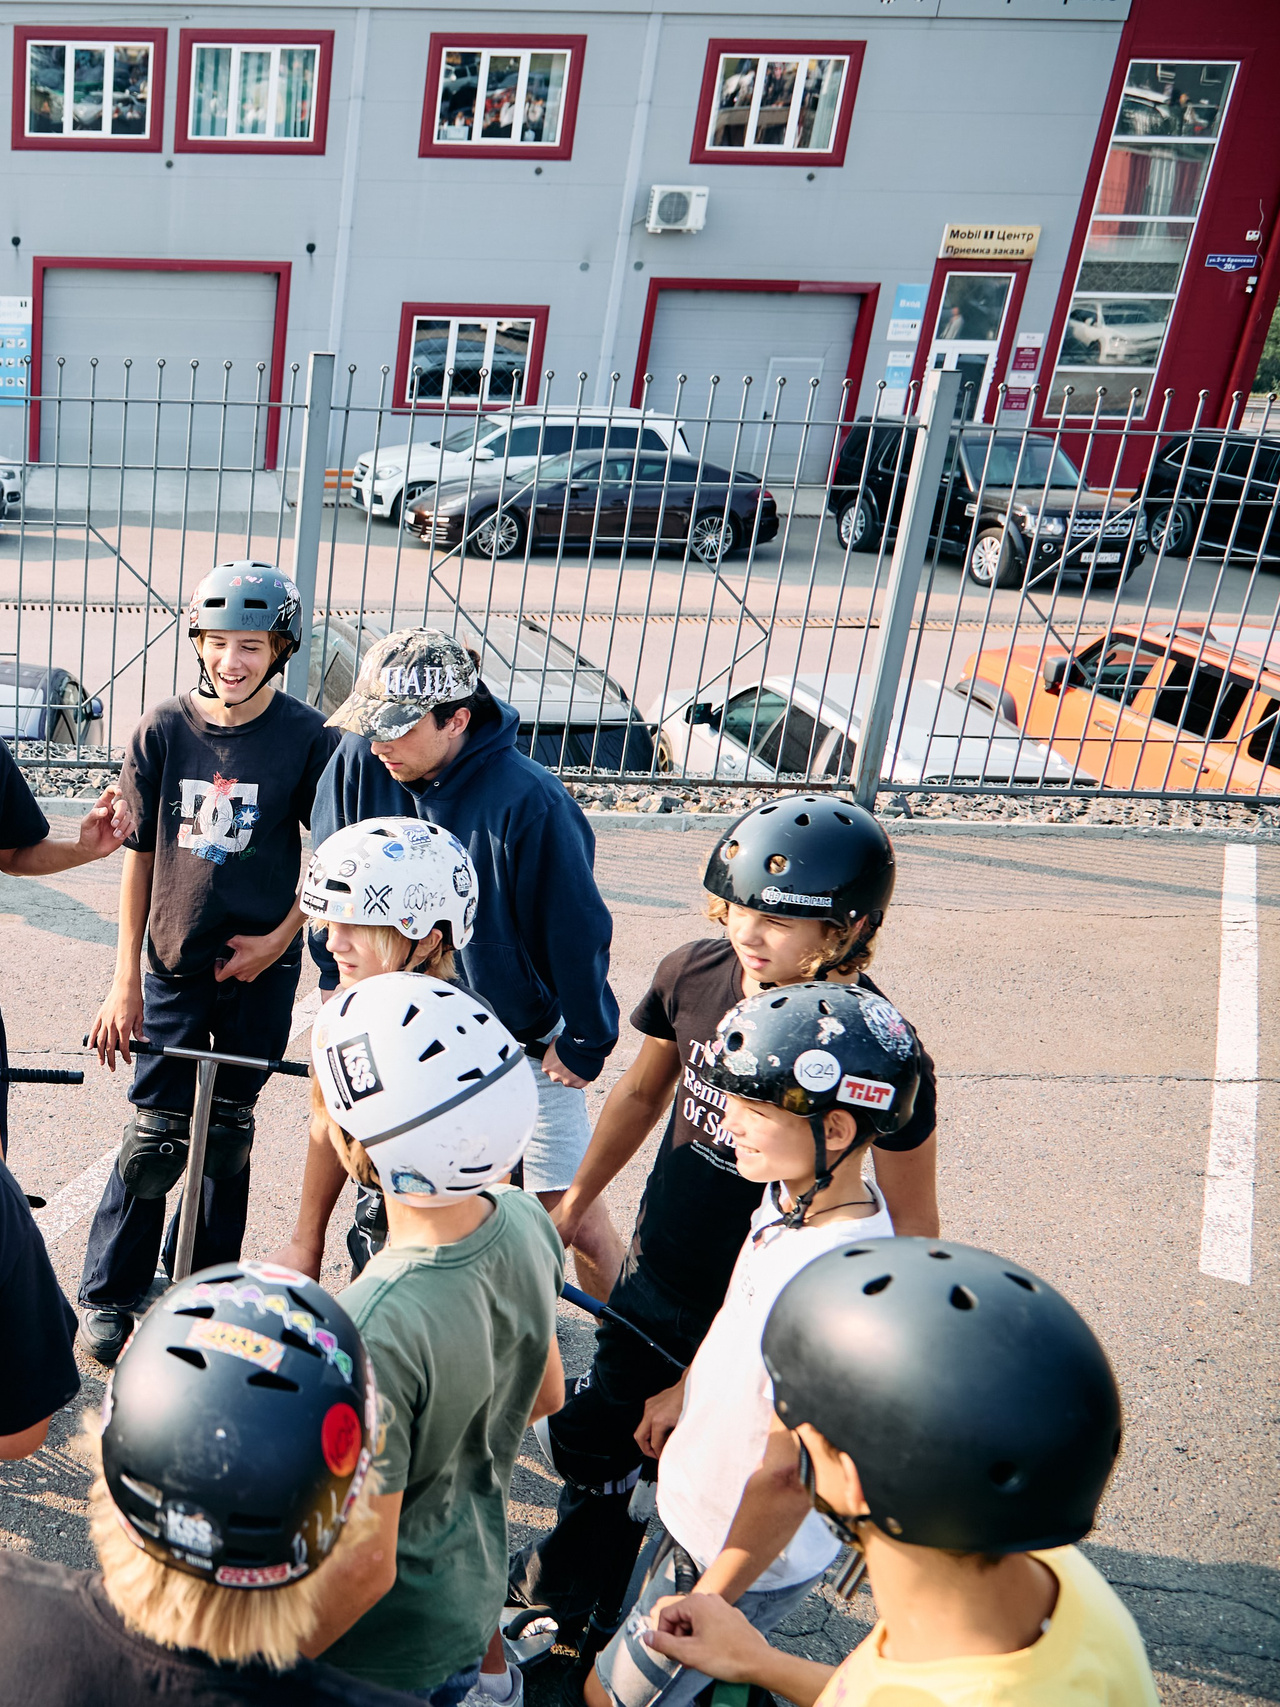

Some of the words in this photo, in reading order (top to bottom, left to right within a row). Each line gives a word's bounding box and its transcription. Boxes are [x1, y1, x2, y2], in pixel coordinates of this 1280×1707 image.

[949, 229, 981, 240] Mobil
[996, 230, 1034, 243] Центр
[945, 245, 991, 256] Приемка
[992, 248, 1025, 256] заказа
[381, 665, 458, 697] ПАПА
[341, 1042, 376, 1093] KSS
[799, 1063, 835, 1079] K24
[682, 1097, 707, 1127] Of
